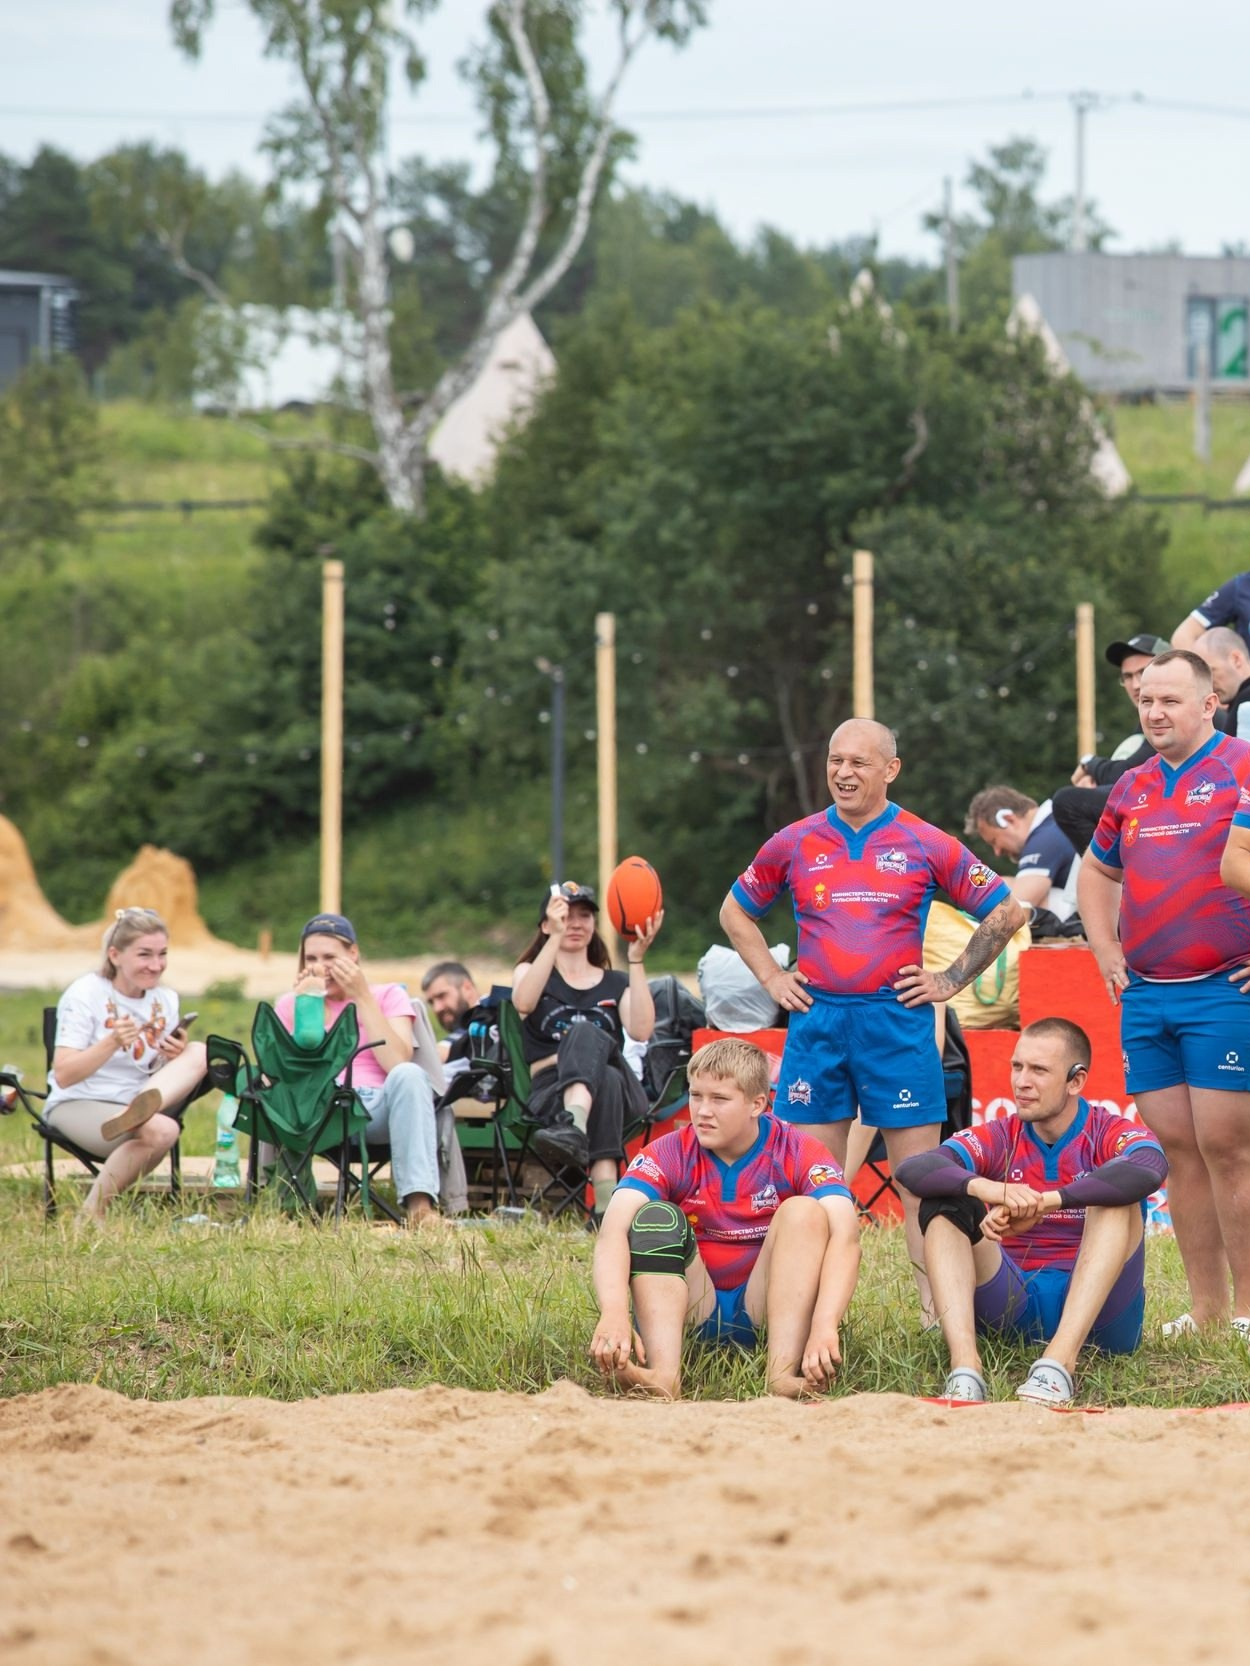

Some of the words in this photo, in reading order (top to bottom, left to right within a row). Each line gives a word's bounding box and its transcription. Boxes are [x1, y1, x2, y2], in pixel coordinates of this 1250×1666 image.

[808, 864, 834, 872] centurion
[1217, 1064, 1245, 1072] centurion
[892, 1101, 920, 1109] centurion
